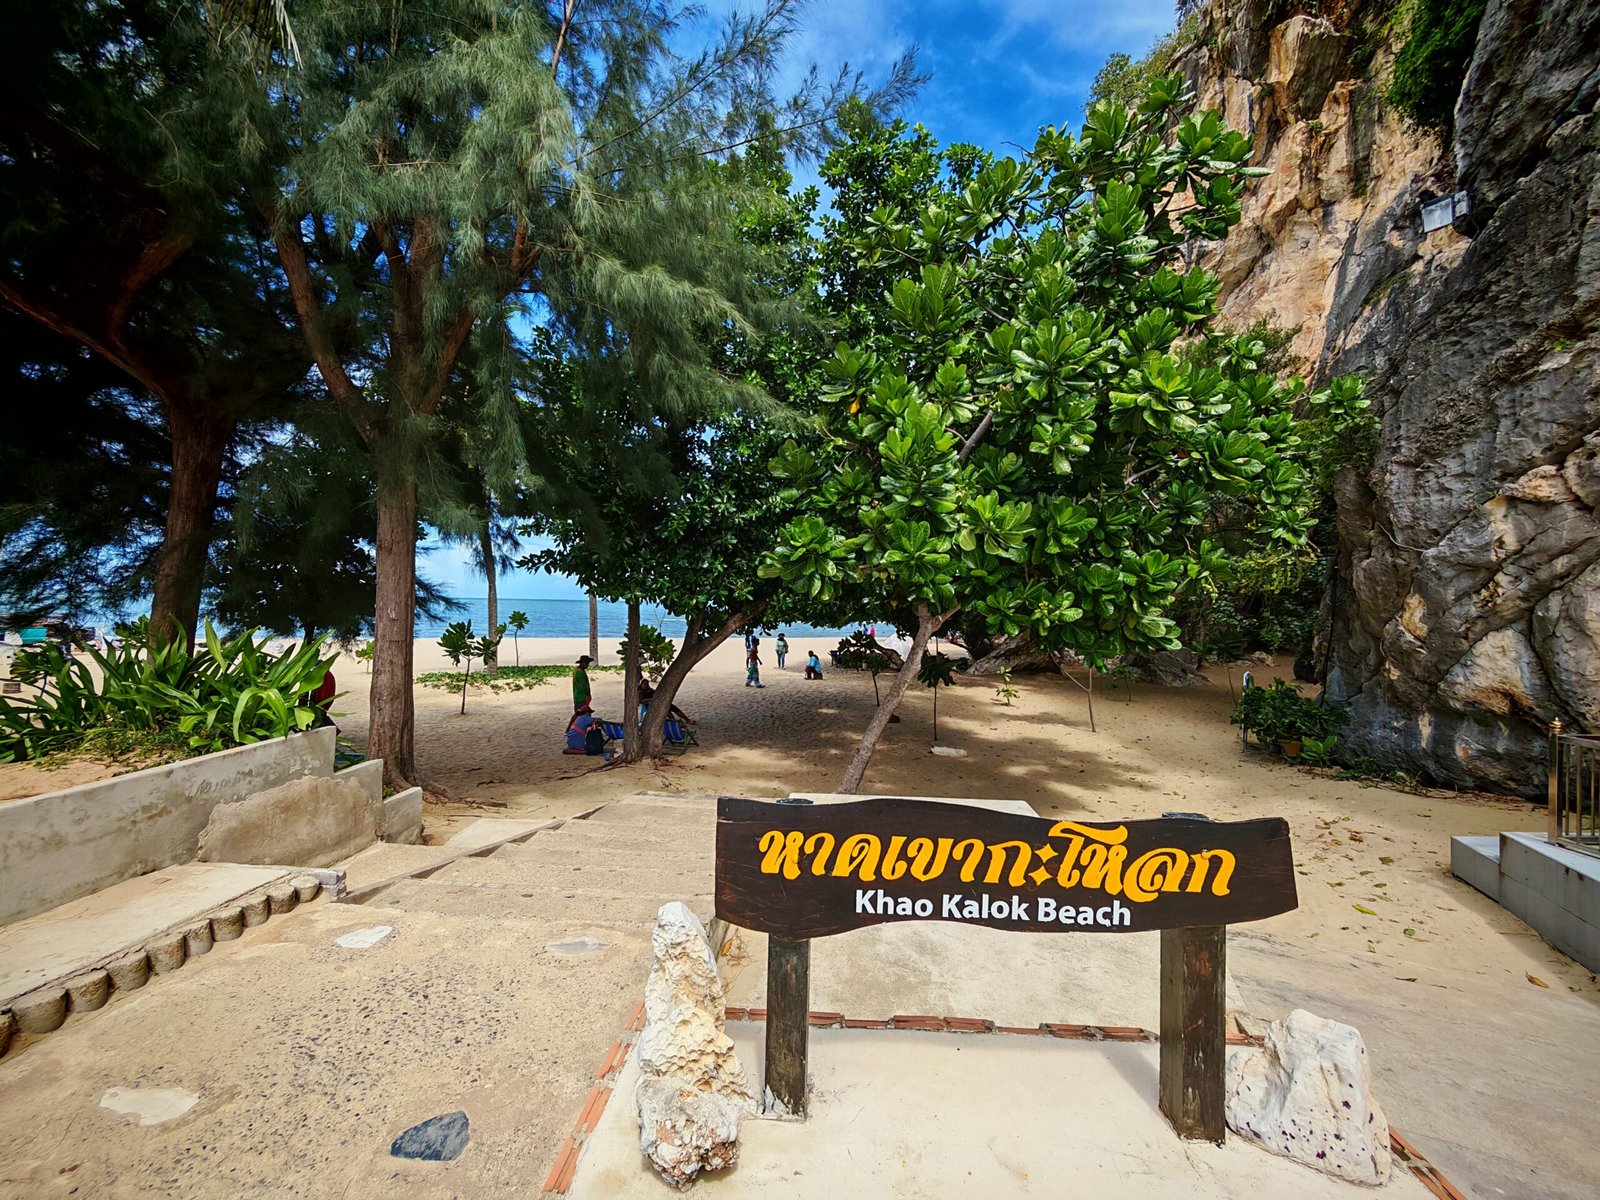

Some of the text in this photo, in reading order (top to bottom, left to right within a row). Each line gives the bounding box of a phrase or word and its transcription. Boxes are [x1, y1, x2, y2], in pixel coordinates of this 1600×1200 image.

[758, 820, 1236, 903] หาดเขากะโหลก
[855, 889, 1132, 928] Khao Kalok Beach
